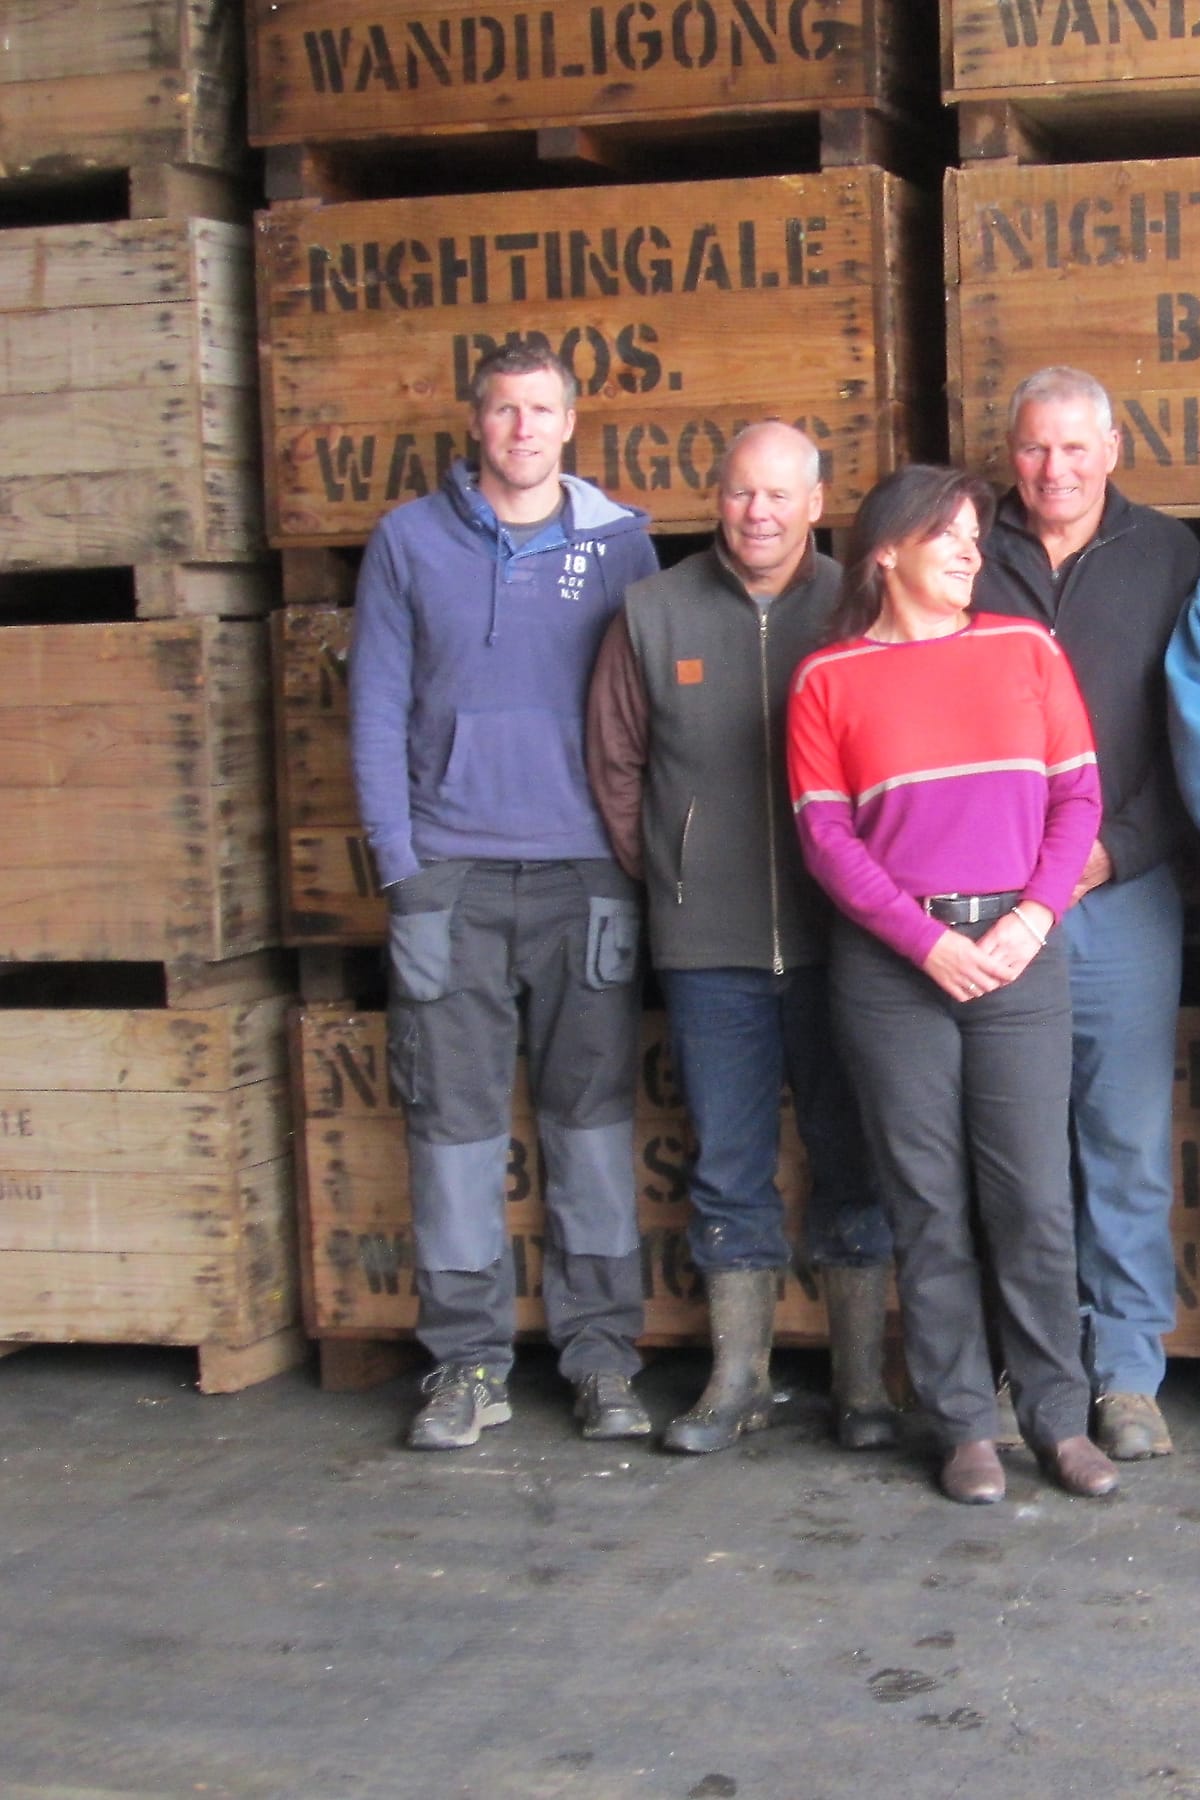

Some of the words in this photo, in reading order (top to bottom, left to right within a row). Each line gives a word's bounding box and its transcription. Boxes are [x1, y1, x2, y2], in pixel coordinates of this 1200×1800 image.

[304, 0, 838, 94] WANDILIGONG
[307, 215, 830, 313] NIGHTINGALE
[453, 322, 683, 403] BOS.
[315, 414, 835, 503] WANLIGO
